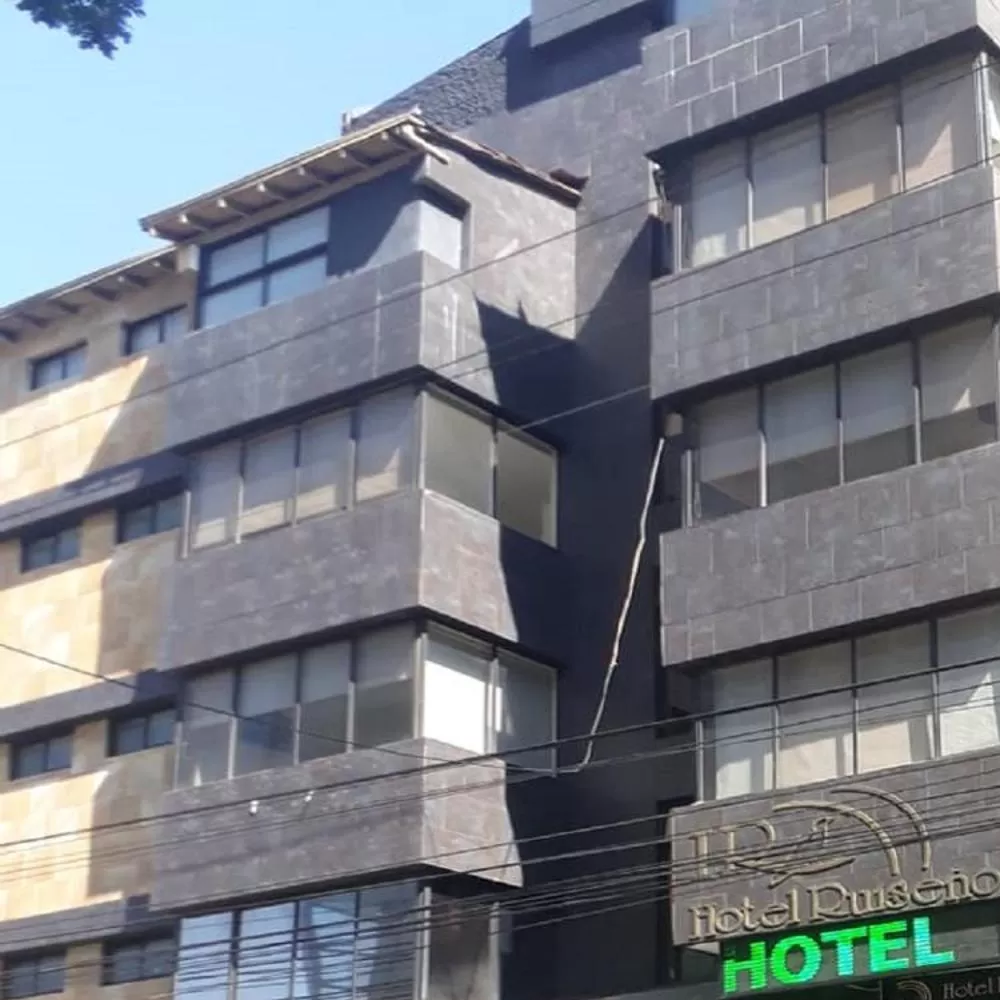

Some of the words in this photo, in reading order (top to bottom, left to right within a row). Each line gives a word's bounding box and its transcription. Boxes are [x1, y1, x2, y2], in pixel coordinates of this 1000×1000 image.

[688, 888, 801, 941] Hotel
[723, 917, 956, 993] HOTEL
[943, 976, 994, 1000] Hotel
